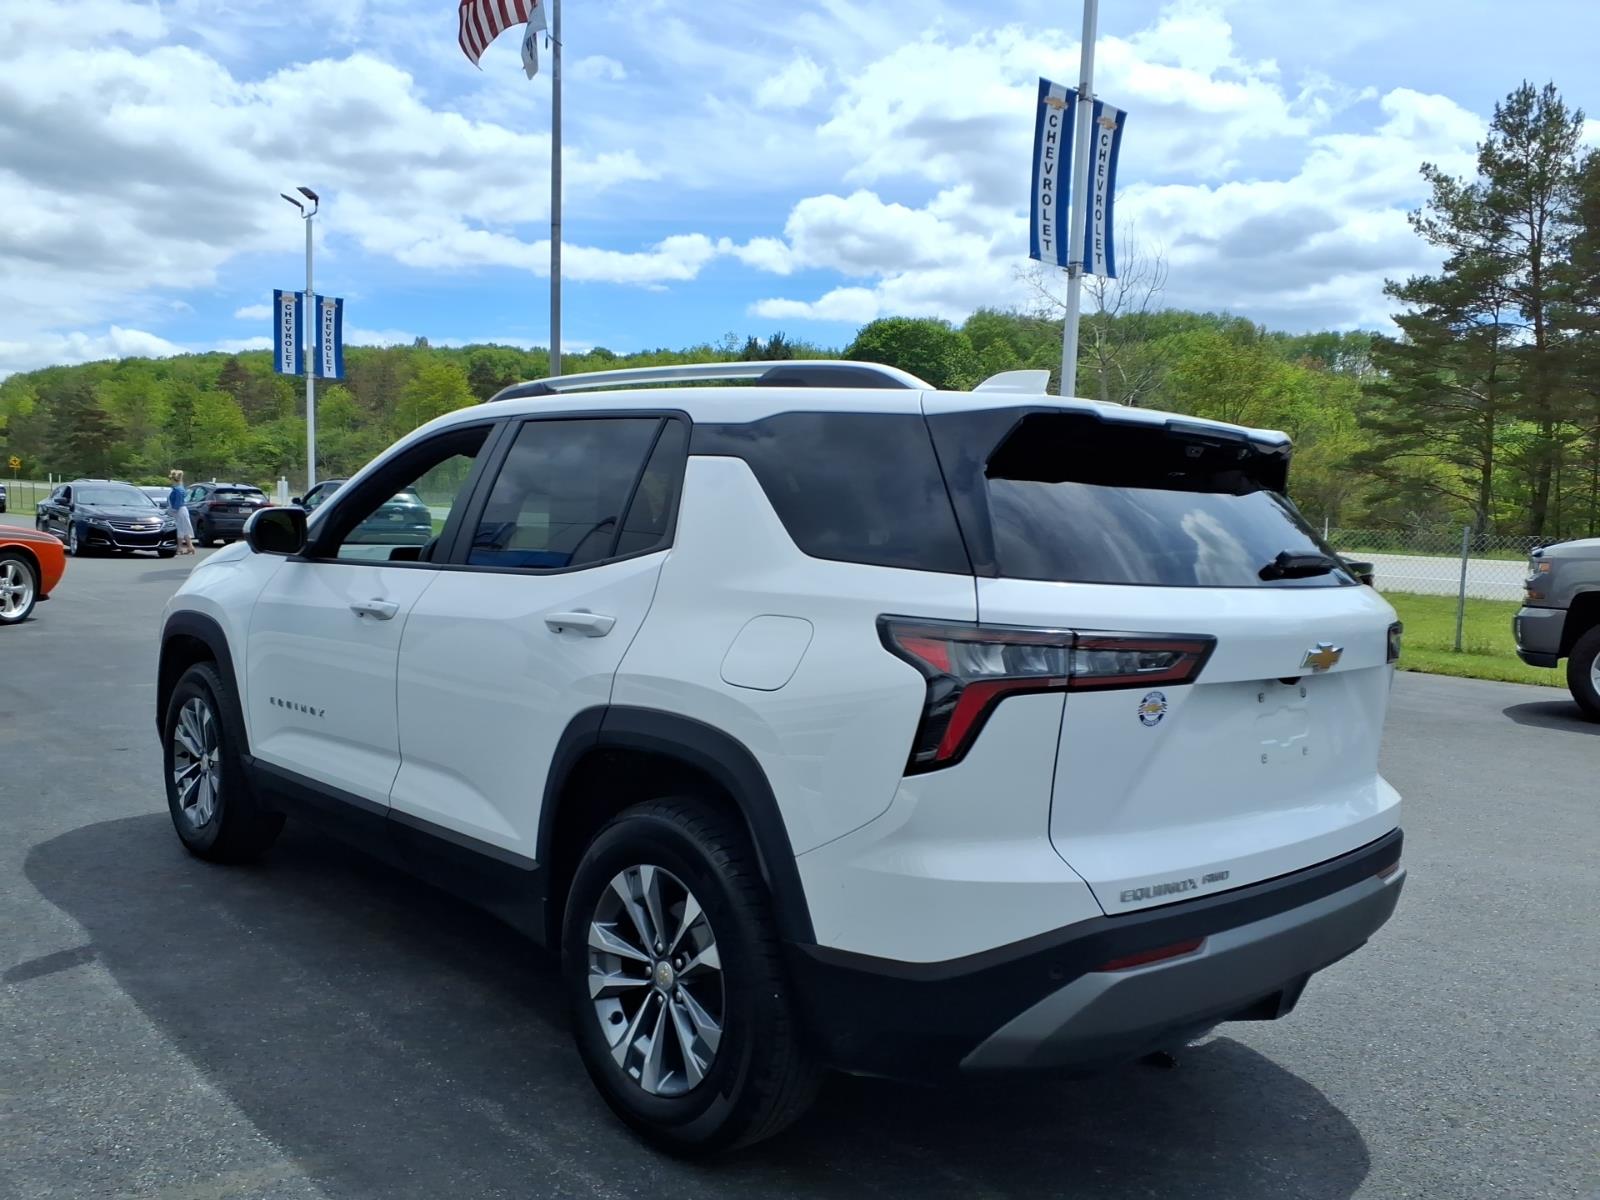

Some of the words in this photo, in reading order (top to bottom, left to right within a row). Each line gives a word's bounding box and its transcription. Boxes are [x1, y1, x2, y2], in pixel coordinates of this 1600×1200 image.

[1041, 114, 1058, 251] CHEVROLET
[1095, 134, 1109, 265] CHEVROLET
[284, 304, 292, 368] CHEVROLET
[1119, 878, 1198, 902] EQUINOX
